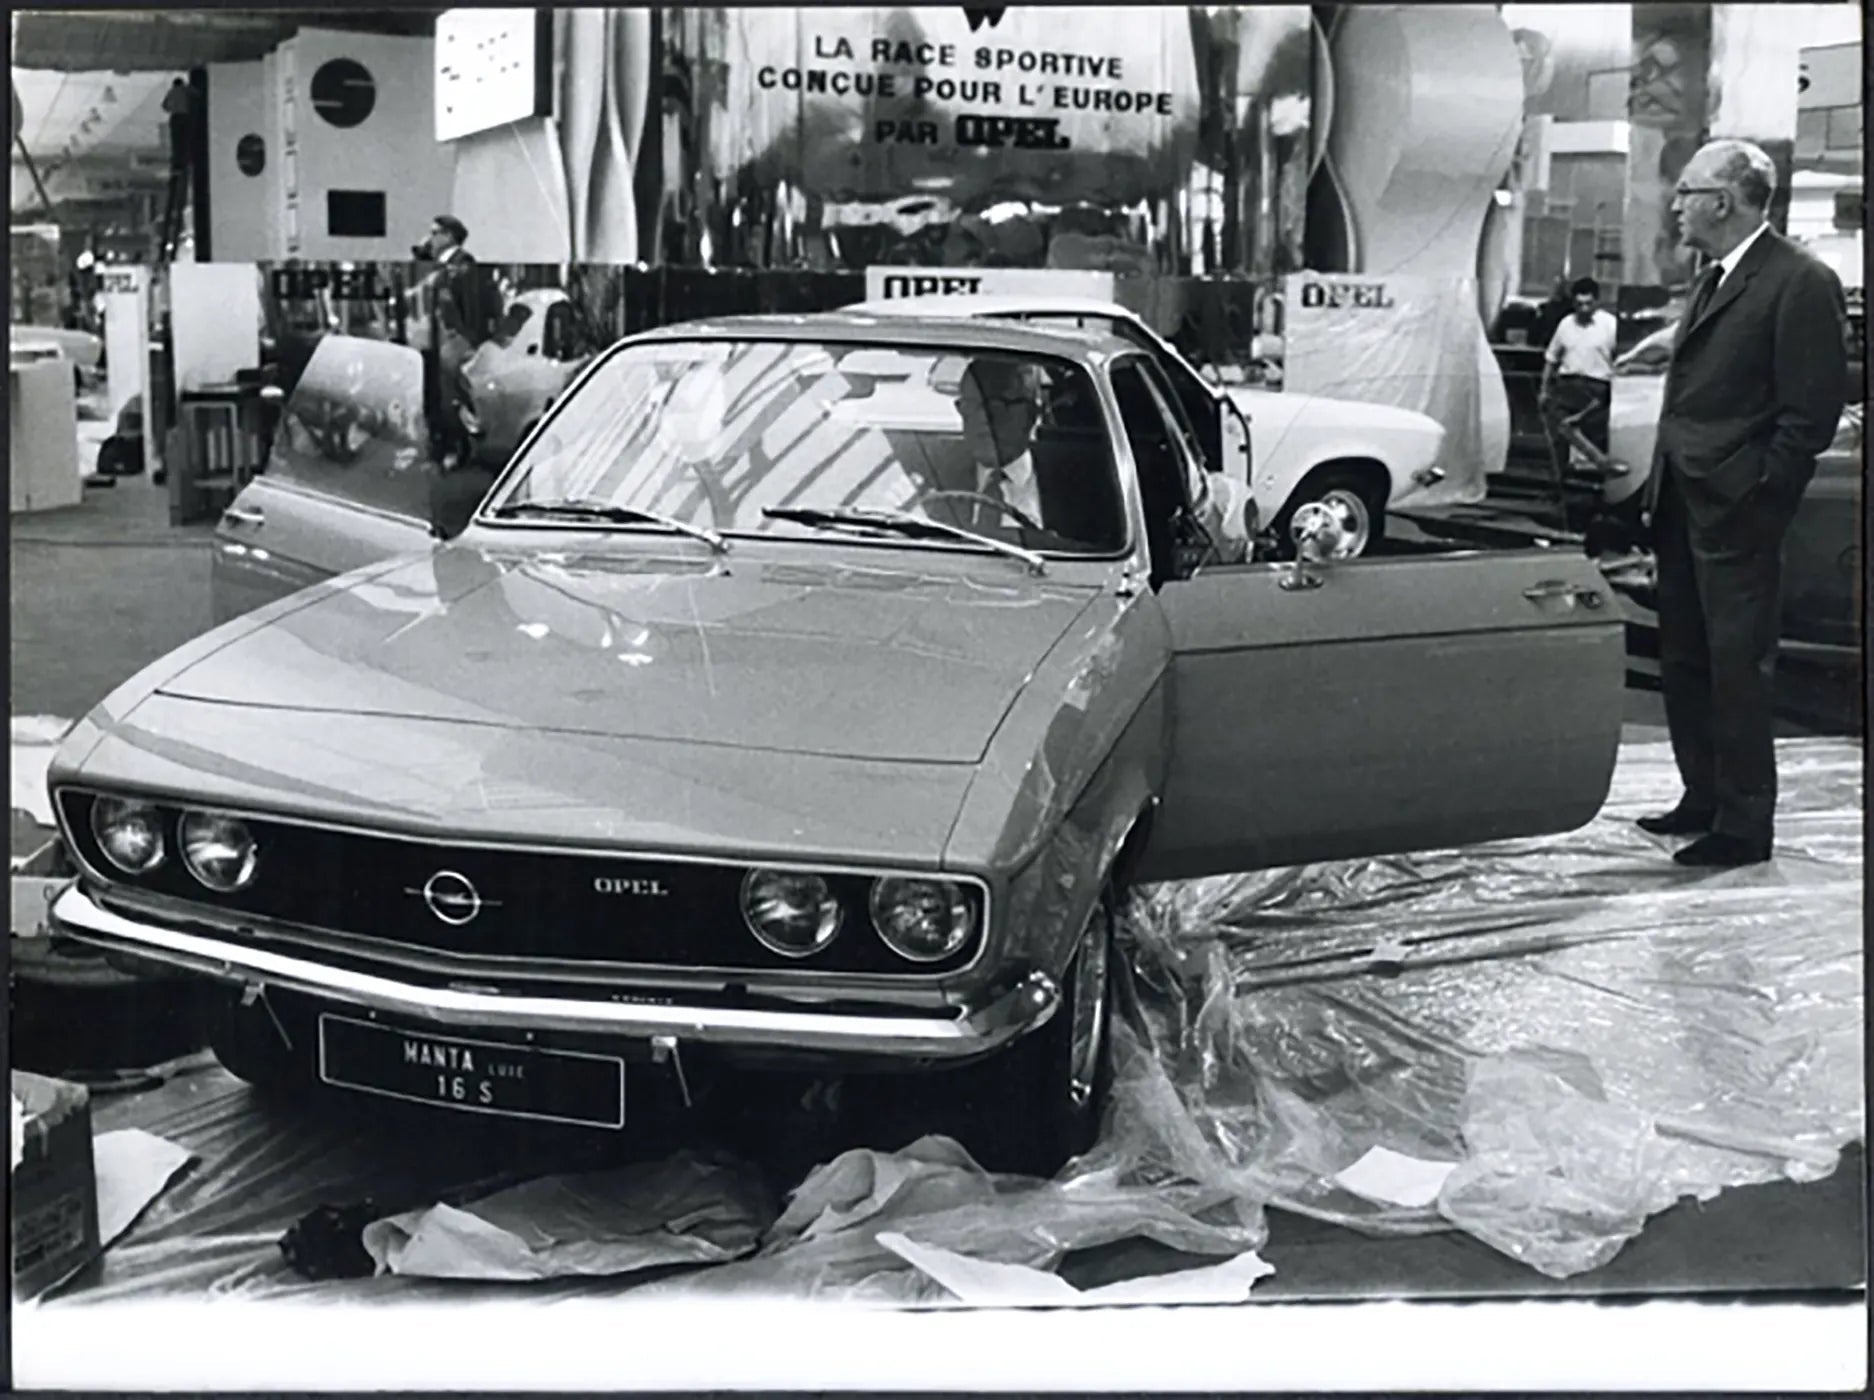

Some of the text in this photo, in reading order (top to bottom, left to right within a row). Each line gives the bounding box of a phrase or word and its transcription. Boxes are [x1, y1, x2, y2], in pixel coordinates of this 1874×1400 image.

[815, 36, 1124, 80] LA RACE SPORTIVE
[914, 78, 1001, 103] POUR
[875, 114, 1071, 150] PAR OPEL
[272, 269, 391, 300] OPEL
[1302, 283, 1395, 309] OPEL
[594, 878, 669, 895] OPEL
[404, 1040, 474, 1071] MANTA
[438, 1075, 493, 1103] 16 S
